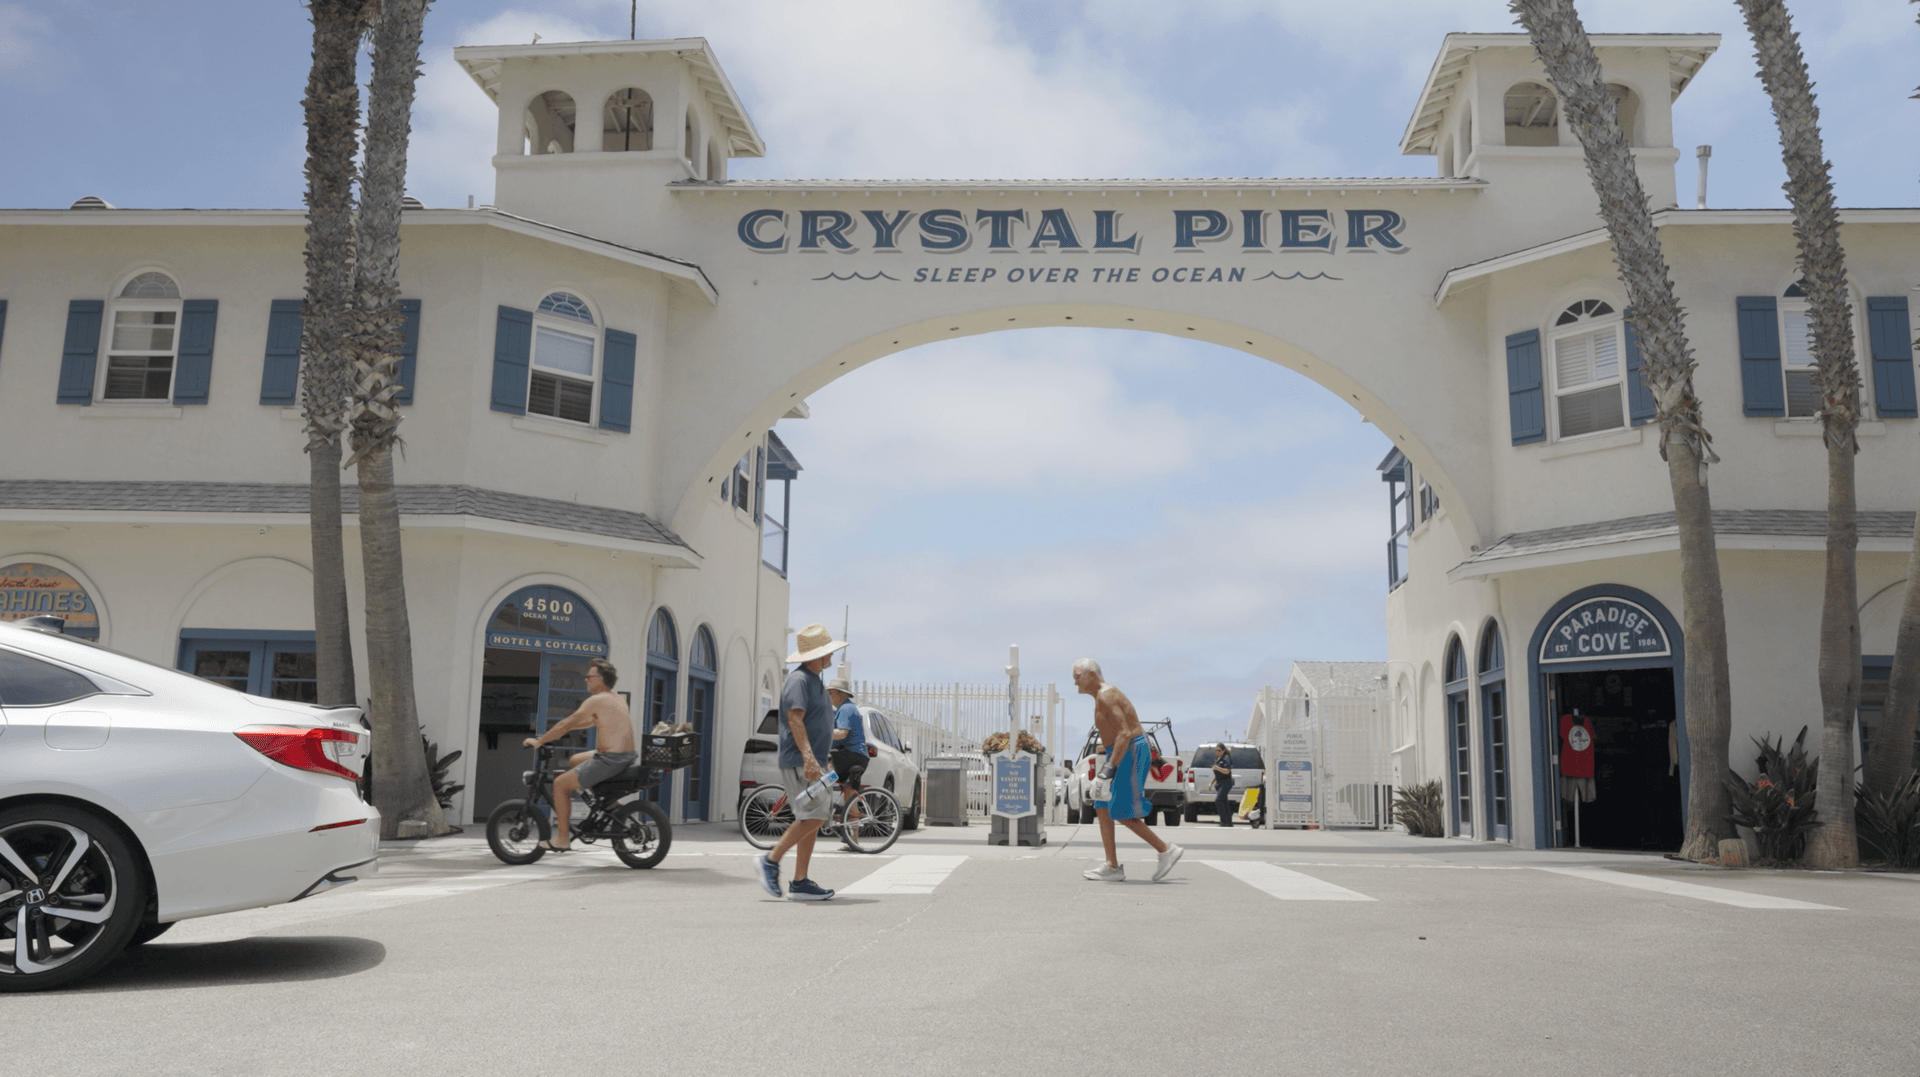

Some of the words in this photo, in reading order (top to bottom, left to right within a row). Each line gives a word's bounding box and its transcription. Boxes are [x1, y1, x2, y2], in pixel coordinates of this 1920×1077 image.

[737, 208, 1143, 255] CRYSTAL
[1172, 208, 1411, 255] PIER
[913, 267, 997, 283] SLEEP
[1007, 267, 1079, 283] OVER
[1092, 267, 1141, 283] THE
[1152, 267, 1246, 283] OCEAN
[523, 597, 574, 615] 4500
[522, 611, 548, 620] OCEAN
[551, 614, 570, 622] BLVD
[1560, 606, 1649, 640] PARADISE
[493, 636, 531, 647] HOTEL
[534, 639, 542, 648] &
[545, 640, 603, 653] COTTAGES
[1555, 644, 1568, 652] EST
[1578, 631, 1631, 653] COVE
[1638, 638, 1656, 647] 1984
